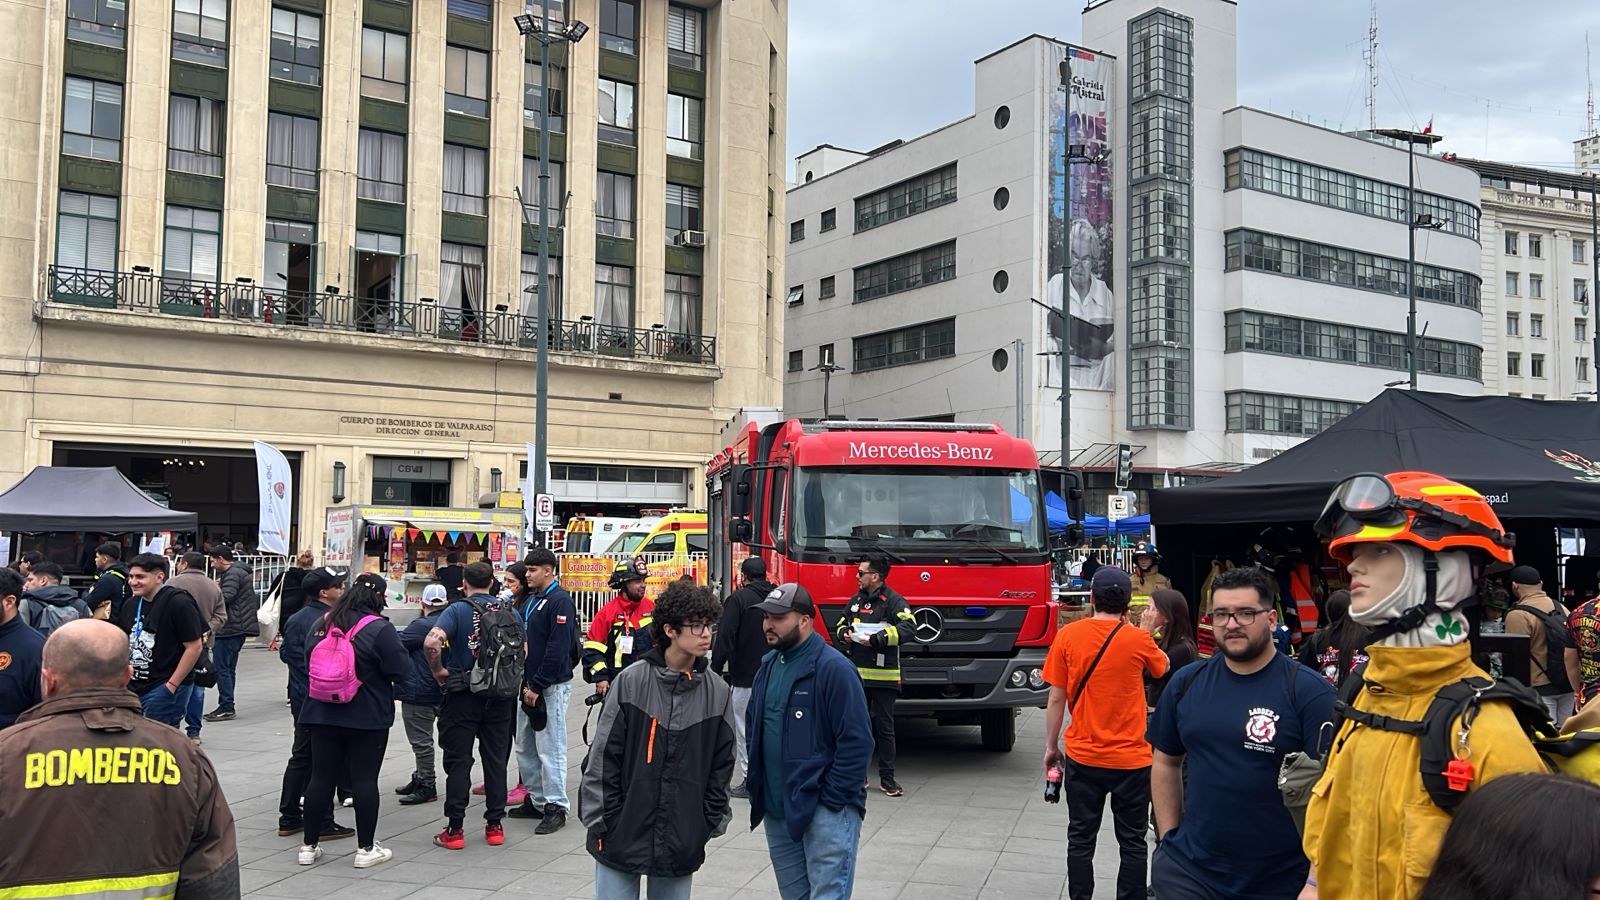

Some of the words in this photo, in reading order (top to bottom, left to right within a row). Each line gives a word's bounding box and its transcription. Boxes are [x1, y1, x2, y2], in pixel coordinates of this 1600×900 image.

[1072, 75, 1104, 91] Gabriela
[1070, 85, 1105, 101] Mistral
[340, 415, 374, 425] CUERPO
[376, 418, 387, 426] DE
[388, 418, 433, 428] BOMBEROS
[434, 421, 446, 429] DE
[447, 422, 494, 432] VALPARAISO
[376, 426, 420, 436] DIRECCION
[423, 429, 461, 438] GENERAL
[848, 441, 994, 460] Mercedes-Benz
[567, 561, 607, 572] Granizados
[25, 746, 181, 789] BOMBEROS
